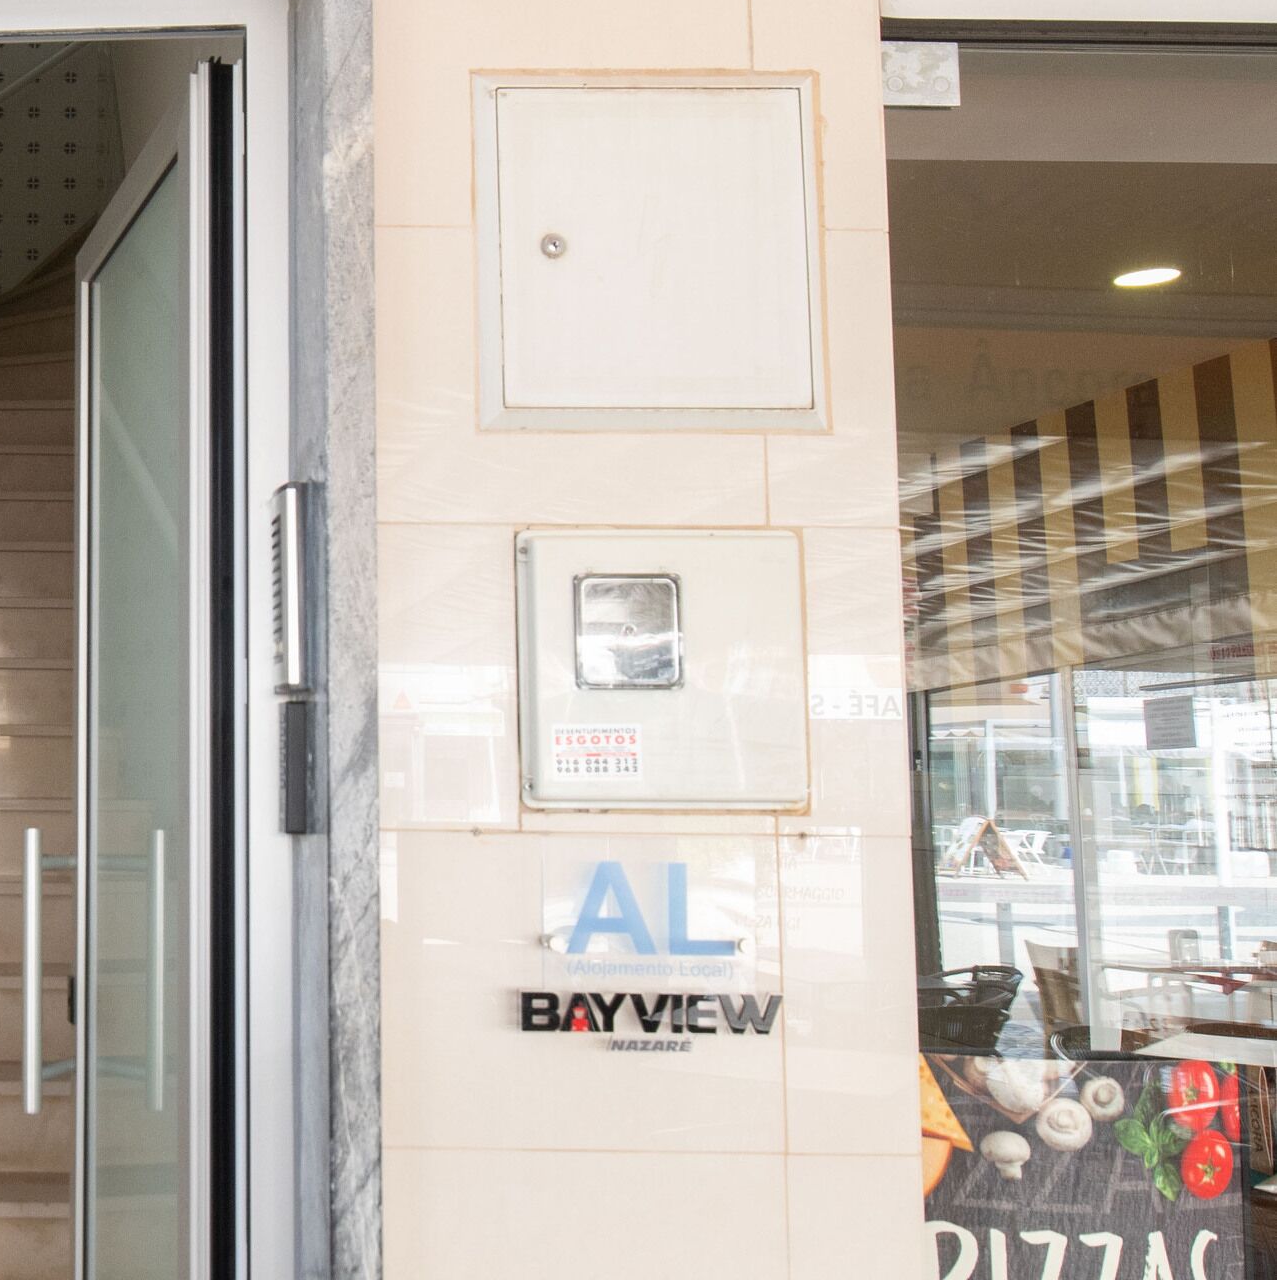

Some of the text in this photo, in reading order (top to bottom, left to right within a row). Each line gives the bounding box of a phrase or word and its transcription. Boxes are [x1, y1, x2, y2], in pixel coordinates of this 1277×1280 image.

[554, 727, 637, 735] DESENTUPIMENTOS
[554, 735, 637, 745] ESGOTOS
[565, 860, 736, 957] AL
[565, 959, 734, 980] (Alojamento Local)
[519, 991, 783, 1035] BAYVIEW
[610, 1036, 692, 1053] NAZARÉ
